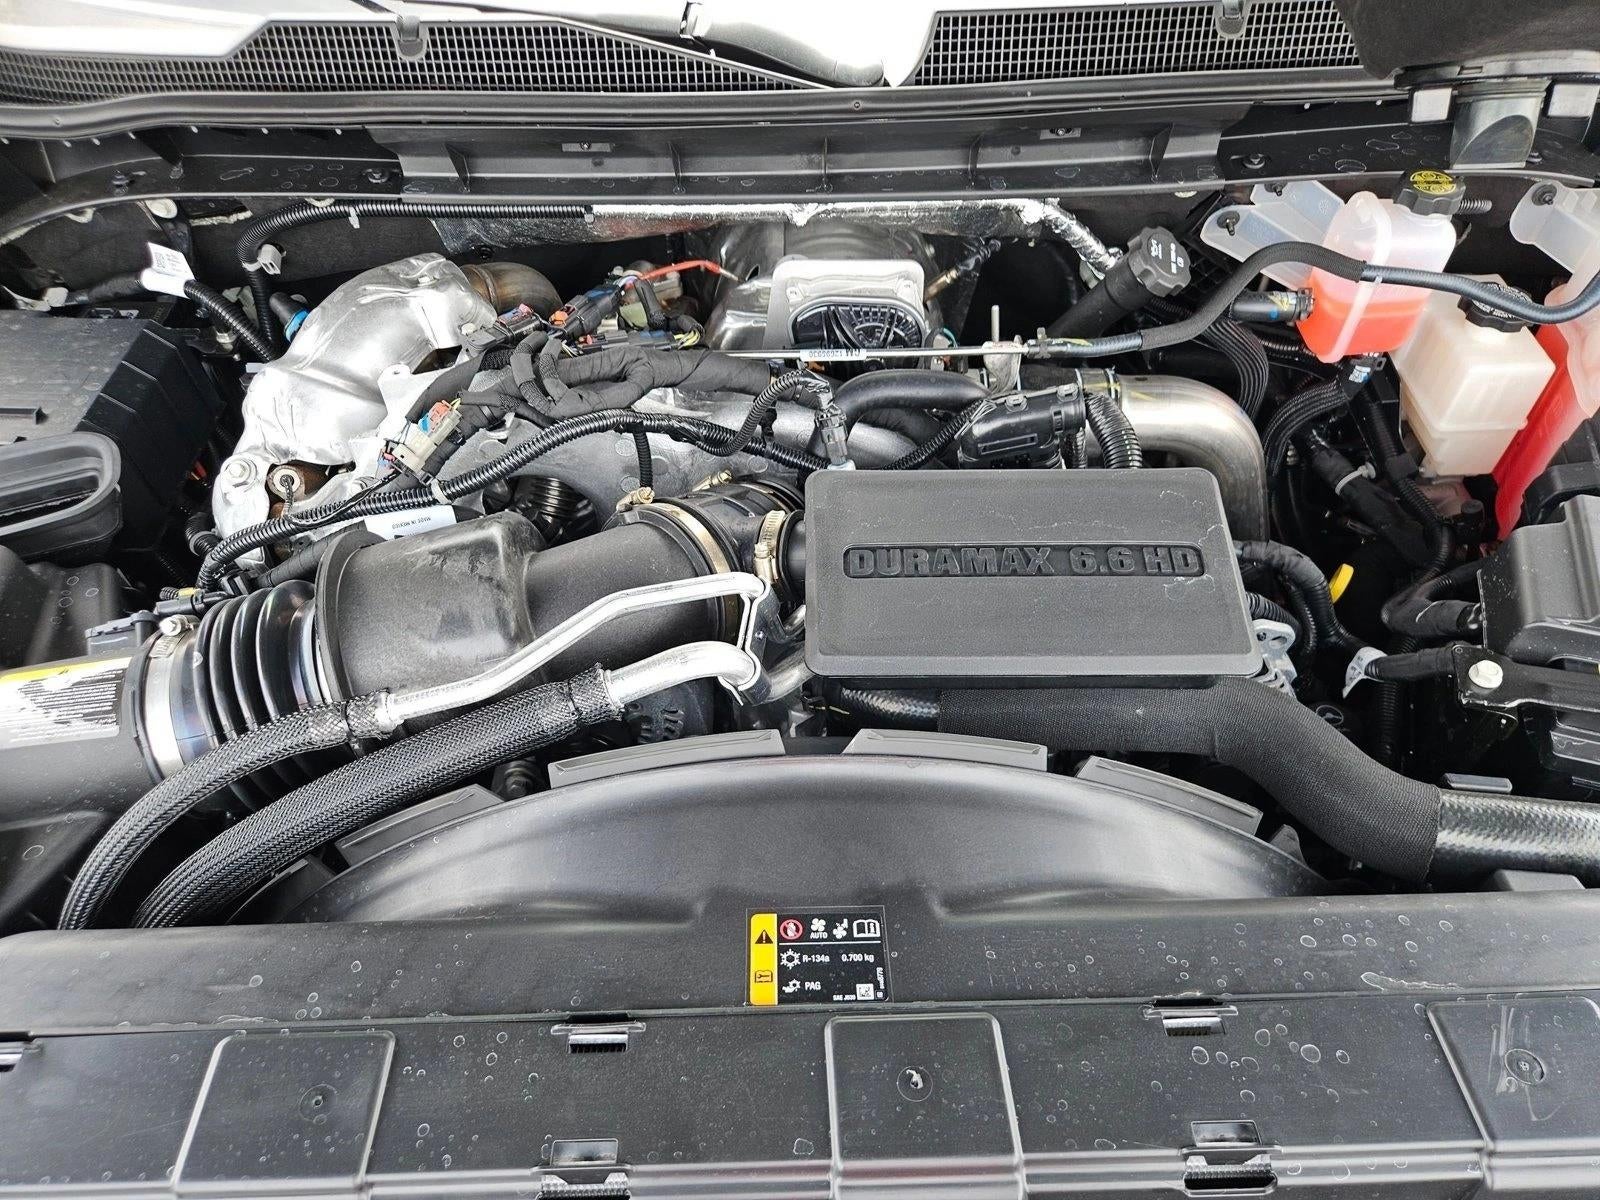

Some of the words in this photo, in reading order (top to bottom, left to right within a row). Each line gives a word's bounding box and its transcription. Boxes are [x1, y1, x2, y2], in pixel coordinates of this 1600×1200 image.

[849, 547, 1054, 576] DURAMAX
[1070, 547, 1135, 573] 6.6
[1143, 547, 1200, 572] HD
[810, 931, 828, 939] AUTO
[802, 954, 830, 963] R-134a
[841, 953, 863, 962] 0.700
[864, 953, 875, 963] kg
[804, 981, 821, 991] PAG
